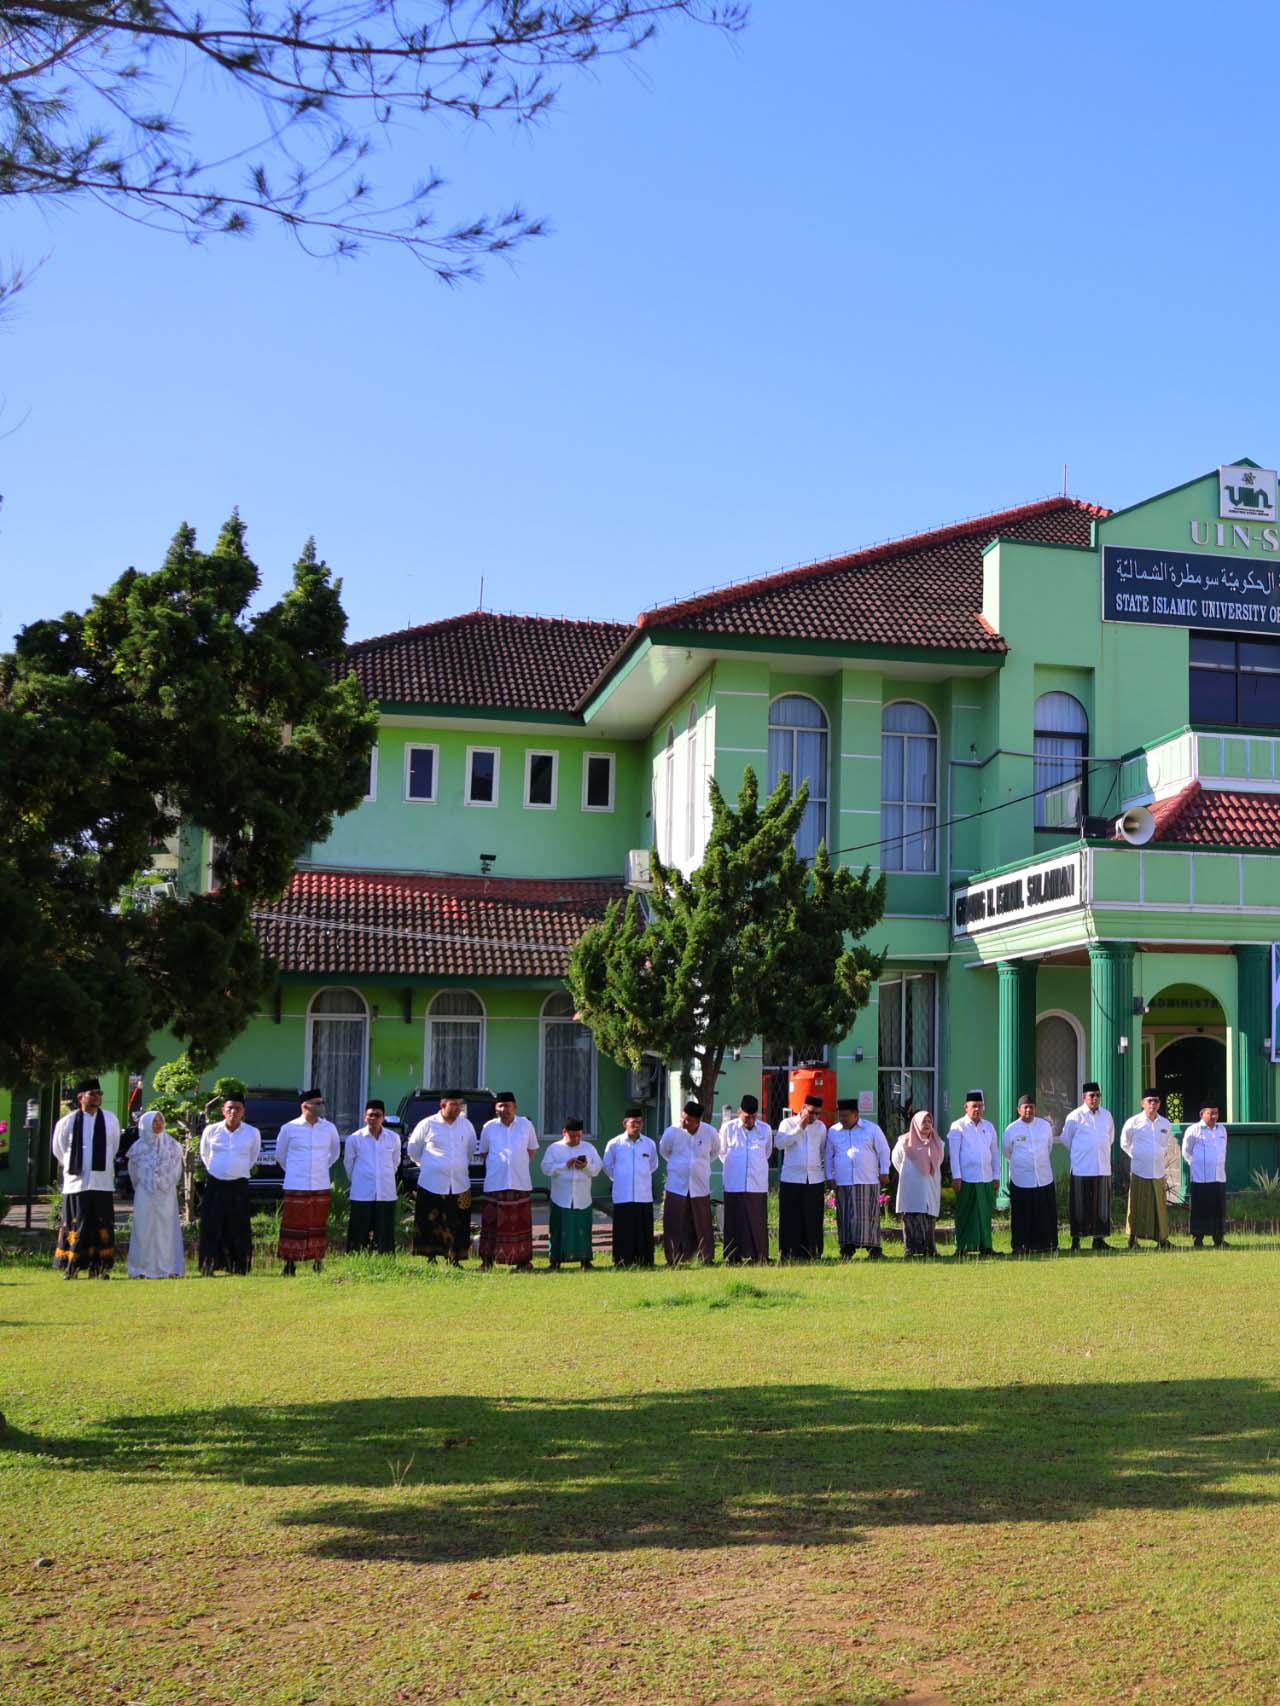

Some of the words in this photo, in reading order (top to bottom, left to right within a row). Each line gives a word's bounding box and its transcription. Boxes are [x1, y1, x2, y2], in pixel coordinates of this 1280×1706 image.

[1115, 593, 1150, 613] STATE
[1152, 596, 1198, 617] ISLAMIC
[1201, 600, 1267, 623] UNIVERSITY
[1026, 864, 1075, 907] SULAIMAN
